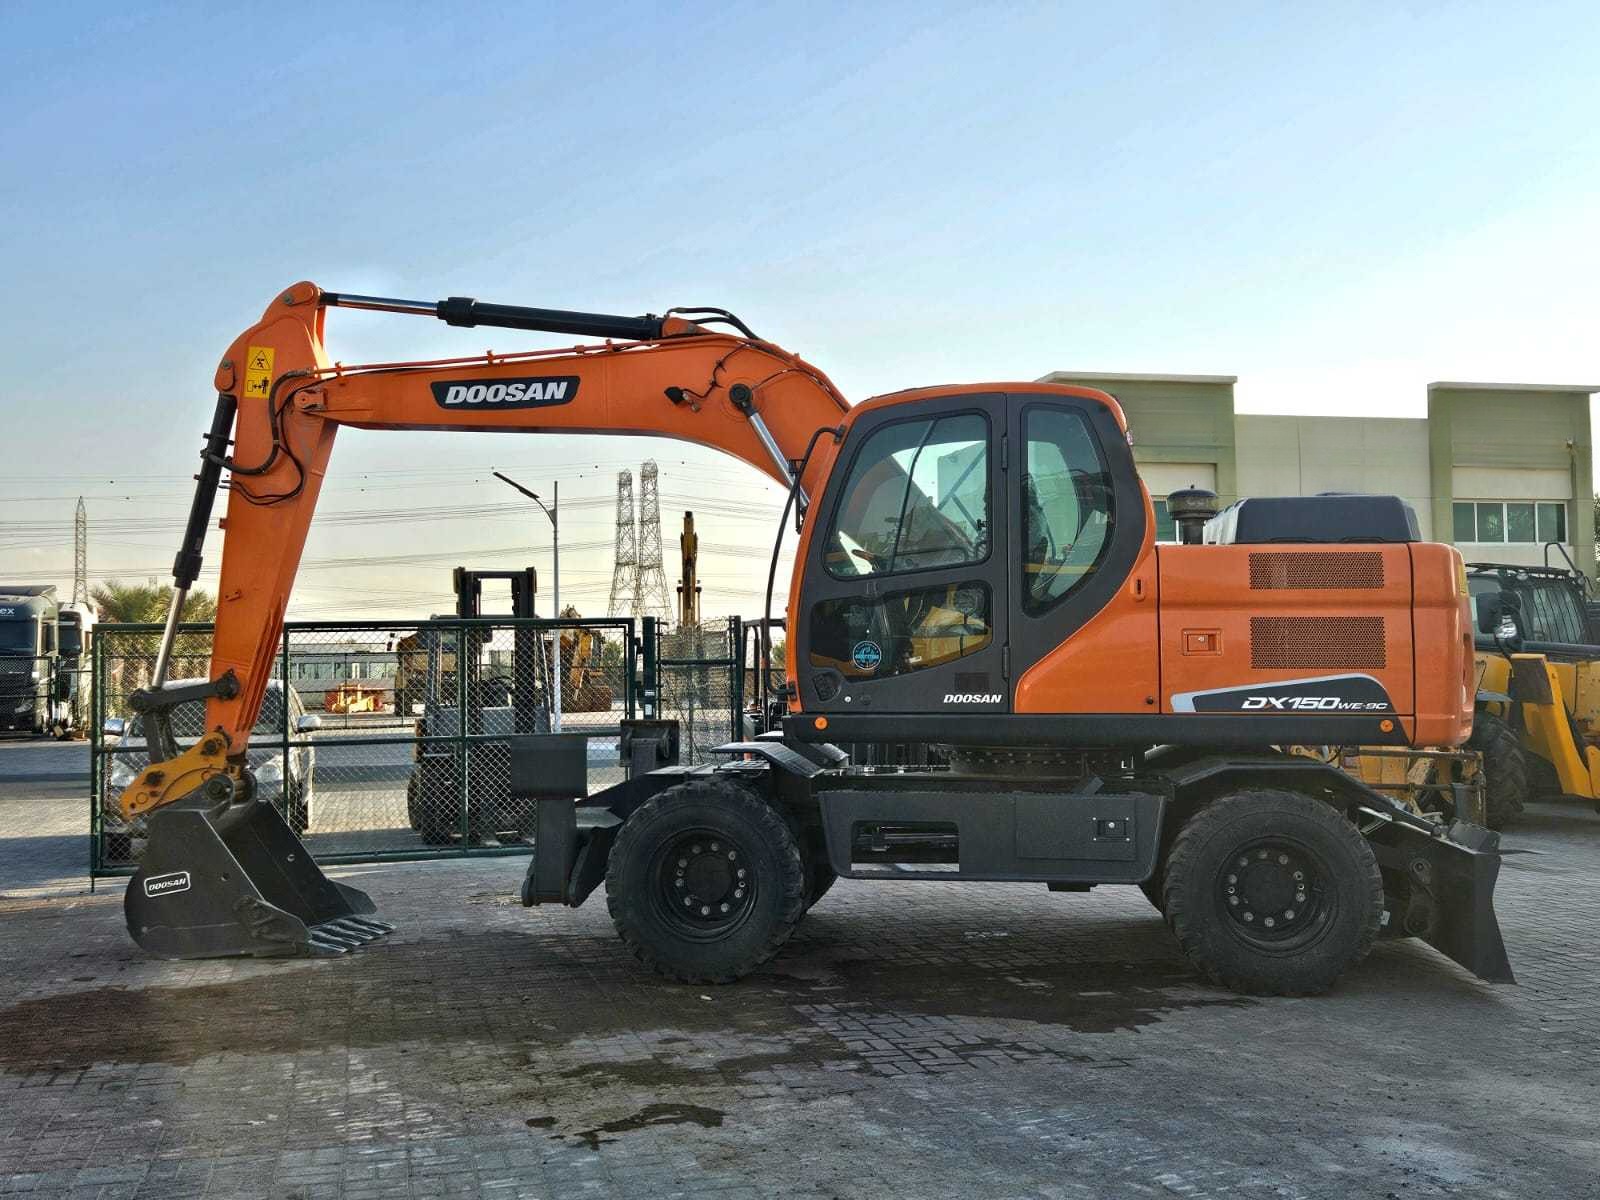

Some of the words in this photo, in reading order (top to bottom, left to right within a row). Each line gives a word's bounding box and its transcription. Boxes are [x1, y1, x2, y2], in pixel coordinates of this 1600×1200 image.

[444, 381, 568, 404] DOOSAN
[943, 693, 1003, 704] DOOSAN
[148, 877, 186, 891] DOOSAN
